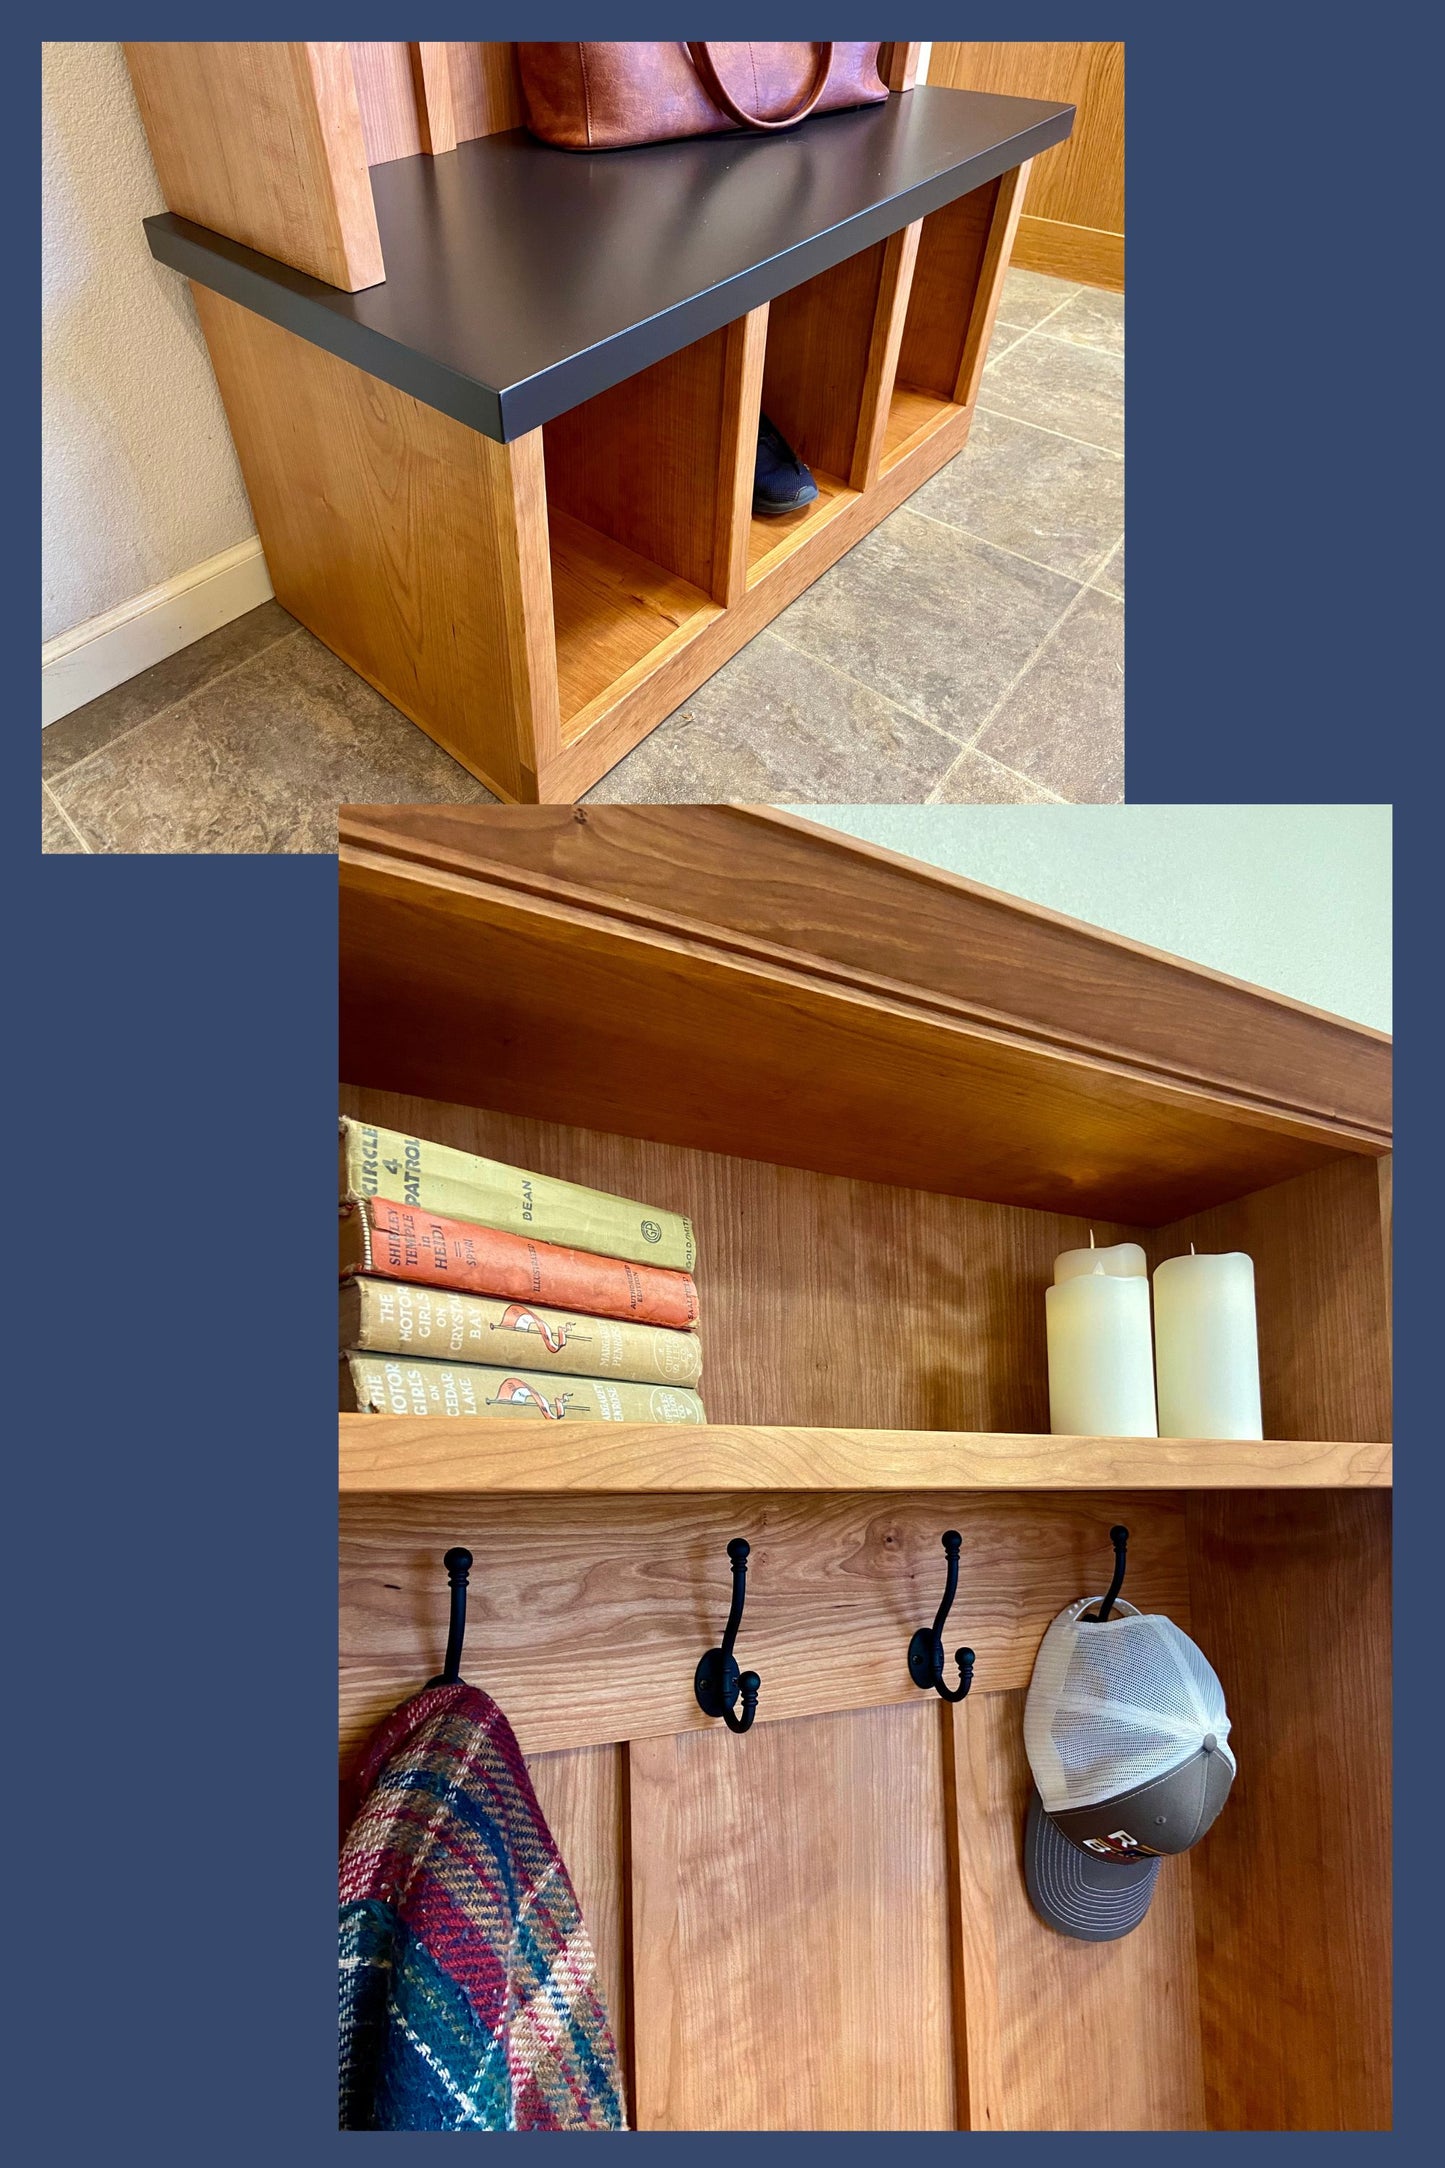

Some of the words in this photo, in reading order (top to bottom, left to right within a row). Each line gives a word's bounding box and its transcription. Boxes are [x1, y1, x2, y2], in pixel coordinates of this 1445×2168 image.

[362, 1127, 379, 1196] CIRCLE
[404, 1139, 421, 1208] PATROL
[522, 1180, 533, 1221] DEAN
[386, 1206, 402, 1266] SHIRLEY
[402, 1213, 418, 1266] TEMPLE
[417, 1235, 431, 1249] in
[430, 1223, 448, 1270] HEIDI
[463, 1238, 477, 1267] SPYRI
[527, 1243, 541, 1293] ILLUSTRATED
[624, 1264, 637, 1310] AUTHORIZED
[633, 1271, 643, 1303] EDITION
[380, 1294, 395, 1323] THE
[399, 1287, 413, 1342] MOTOR
[418, 1293, 431, 1338] GIRLS
[437, 1307, 448, 1328] ON
[467, 1307, 482, 1340] BAY
[596, 1319, 611, 1367] MARGARET
[609, 1325, 624, 1367] PENROSE
[367, 1375, 387, 1406] THE
[408, 1369, 428, 1416] GIRLS
[429, 1384, 440, 1401] ON
[441, 1371, 461, 1417] CEDAR
[459, 1376, 478, 1415] LAKE
